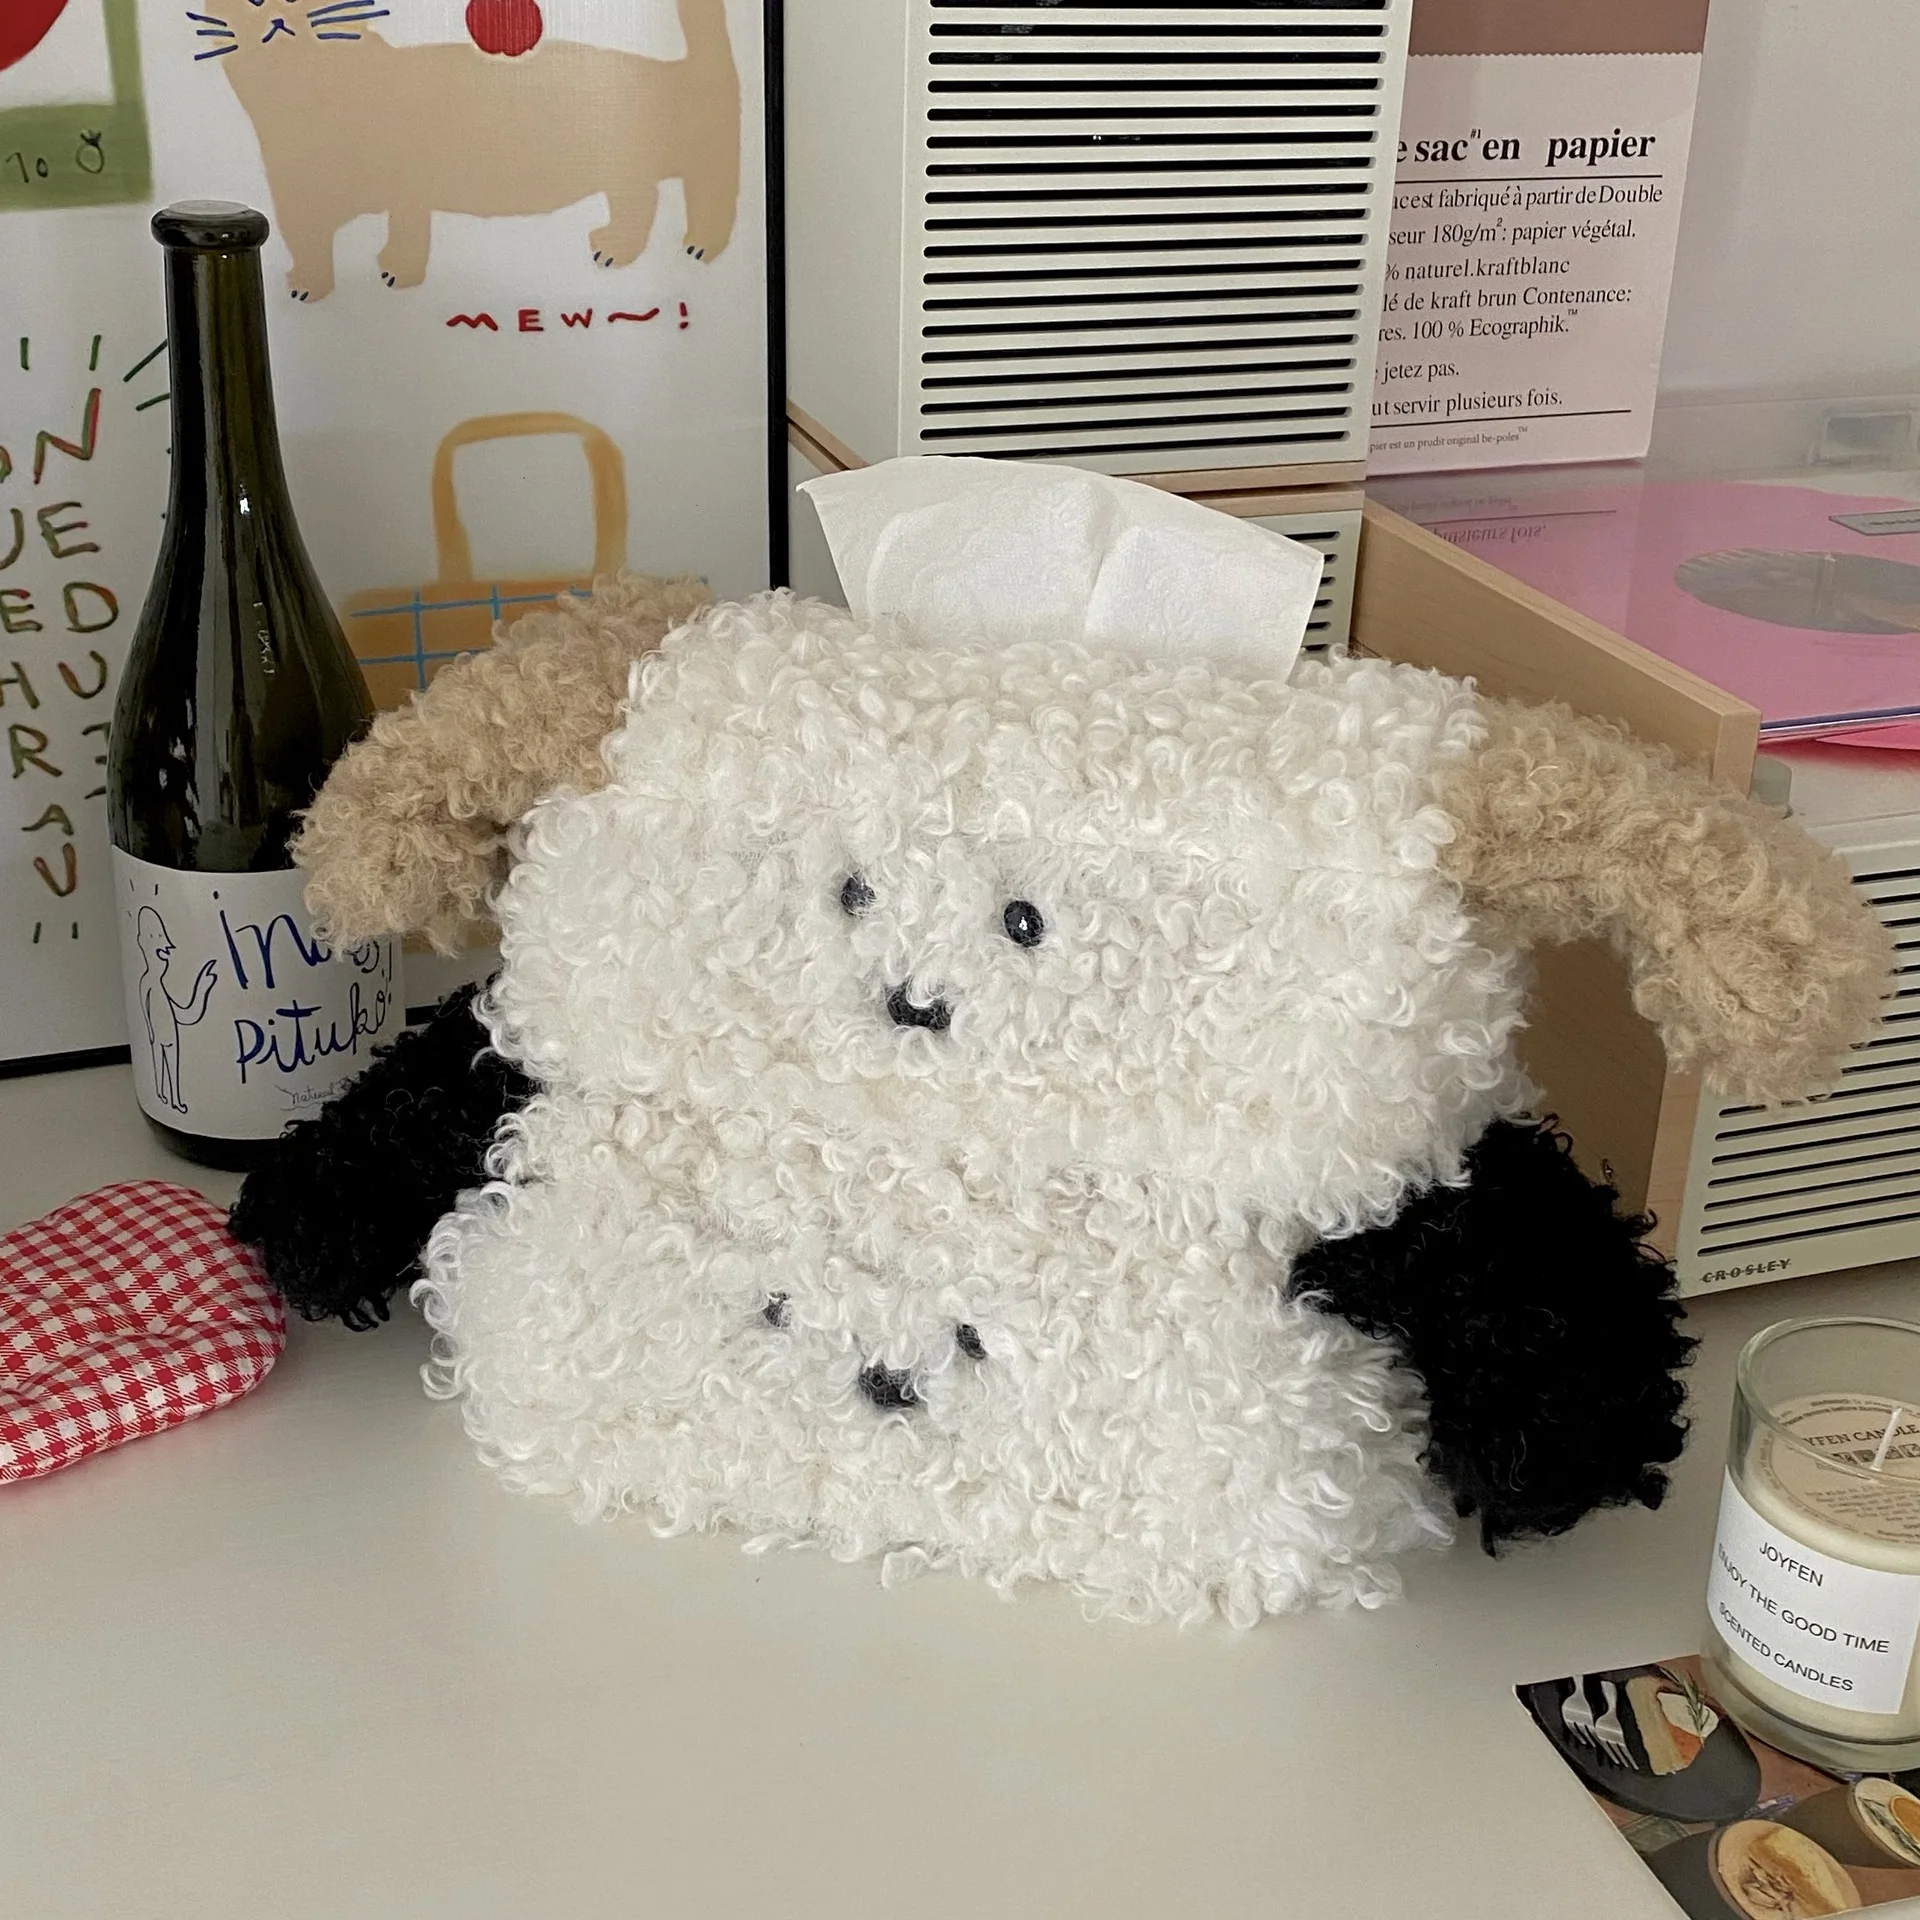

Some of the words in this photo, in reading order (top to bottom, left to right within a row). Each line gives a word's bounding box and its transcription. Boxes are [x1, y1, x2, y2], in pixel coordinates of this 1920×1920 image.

[1482, 138, 1520, 161] en
[1545, 128, 1656, 167] papier
[1438, 185, 1510, 212] fabriqué
[1598, 184, 1663, 204] Double
[1511, 220, 1567, 246] papier
[1572, 218, 1636, 244] végétal.
[1404, 291, 1425, 311] de
[1430, 290, 1471, 310] kraft
[1477, 288, 1517, 307] brun
[1522, 286, 1632, 305] Contenance:
[1413, 320, 1443, 340] 100
[1448, 320, 1465, 339] %
[1381, 361, 1423, 385] jetez
[1428, 362, 1460, 382] pas.
[1393, 394, 1440, 416] servir
[1446, 392, 1523, 417] plusieurs
[1527, 387, 1563, 407] fois.
[1700, 1258, 1792, 1284] CROSLEY
[1759, 1541, 1824, 1588] JOYFEN
[1749, 1583, 1778, 1616] THE
[1781, 1608, 1837, 1642] GOOD
[1843, 1632, 1891, 1654] TIME
[1718, 1601, 1771, 1658] SCENTED
[1773, 1652, 1854, 1692] CANDLES
